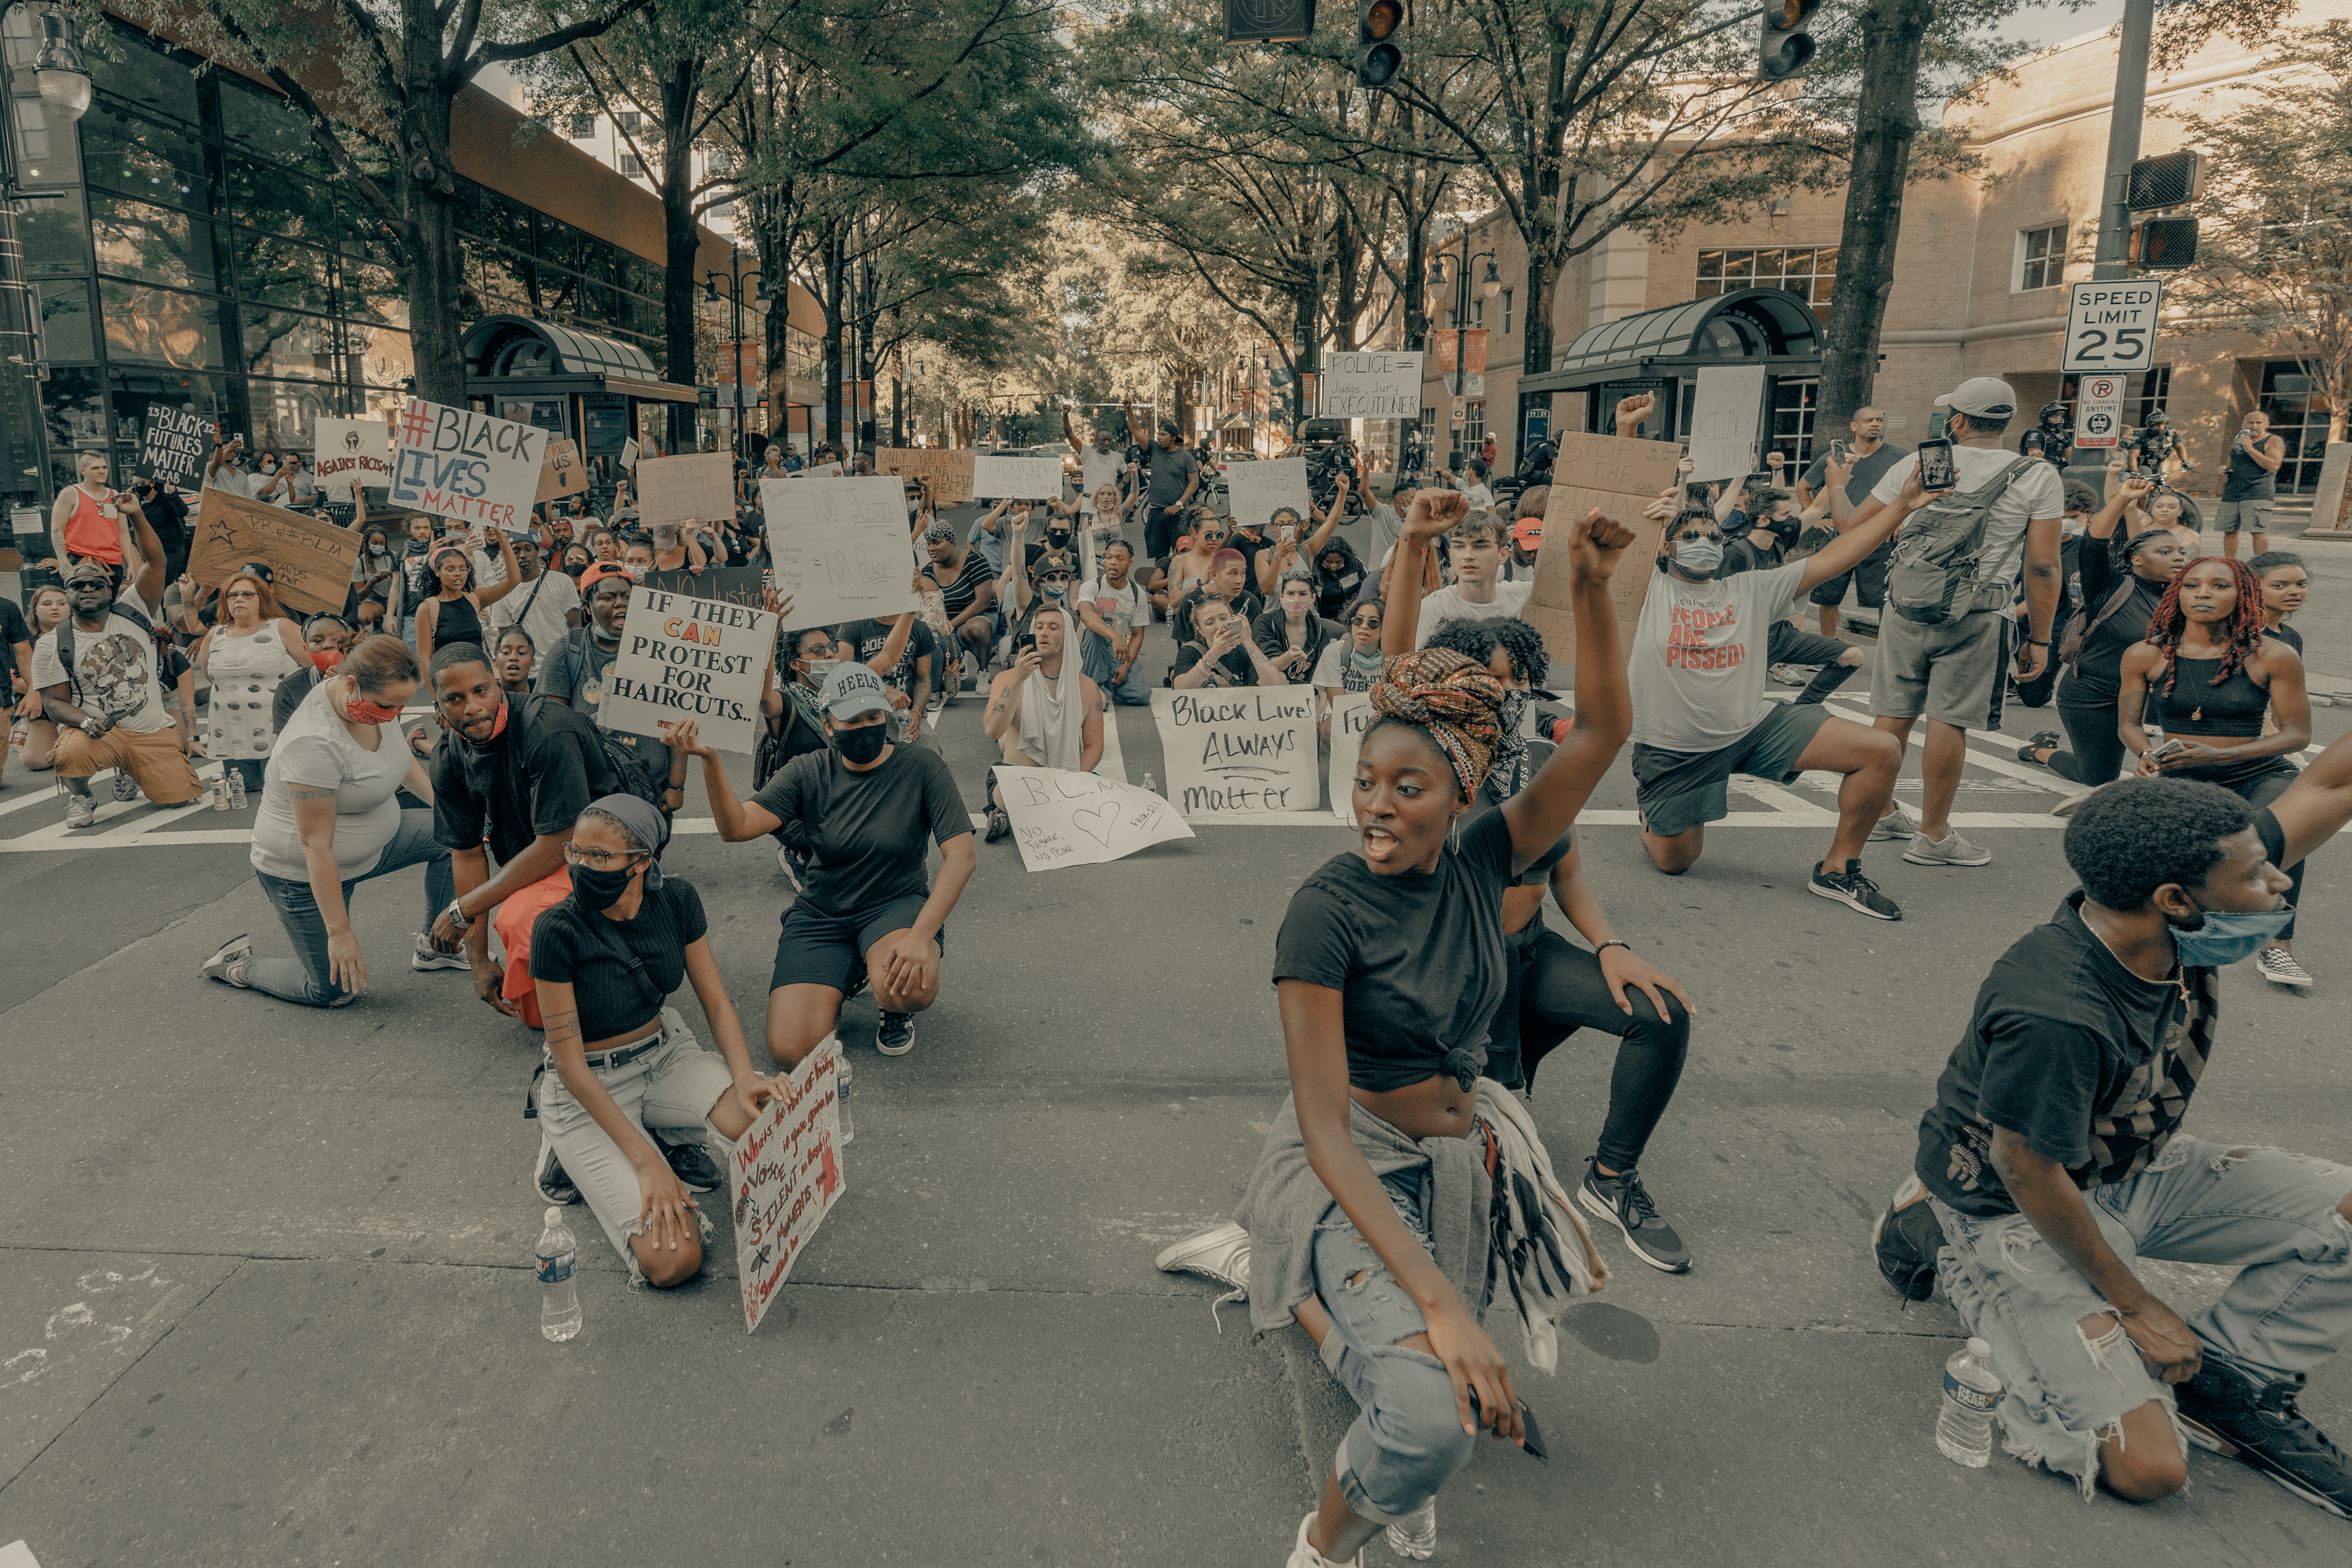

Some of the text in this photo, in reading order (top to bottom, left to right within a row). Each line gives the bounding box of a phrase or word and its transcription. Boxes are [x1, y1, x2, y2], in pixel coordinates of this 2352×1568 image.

[2079, 291, 2152, 306] SPEED
[2084, 310, 2141, 324] LIMIT
[2074, 328, 2147, 361] 25
[1333, 355, 1392, 373] POLICE
[1371, 381, 1398, 395] Jury
[1716, 375, 1755, 408] STOP
[1329, 396, 1418, 414] EXECUTIONER
[148, 407, 216, 437] 13 BLACK 12
[402, 400, 534, 463] #BLACK
[1698, 409, 1744, 442] KILLING
[146, 427, 203, 456] FUTURES
[1564, 438, 1634, 463] STOP
[142, 446, 200, 478] MATTER.
[317, 455, 389, 477] AGAINST RACISM
[880, 451, 962, 464] ONLY YOU CAN
[989, 461, 1058, 472] FIGHTING
[152, 468, 180, 484] ACAB
[394, 448, 490, 501] LIVES
[929, 474, 971, 485] RUTALITY
[1004, 473, 1042, 482] FOR MY
[1235, 463, 1302, 480] RASTAFARIAN
[1594, 462, 1635, 482] THE
[933, 483, 970, 495] PEACE
[993, 485, 1060, 494] SONS FUTURE
[422, 488, 515, 527] MATTER
[811, 490, 838, 522] NO
[1239, 499, 1273, 515] WANT
[266, 559, 308, 580] STANDS
[824, 549, 852, 588] NO
[645, 591, 764, 630] IF THEY
[1672, 603, 1736, 629] PEOPLE
[663, 617, 722, 647] CAN
[1667, 625, 1709, 648] ARE
[629, 636, 752, 674] PROTEST
[1667, 643, 1746, 670] PISSED!
[661, 665, 711, 694] FOR
[837, 673, 880, 698] HEELS
[612, 677, 752, 722] HAIRCUTS...
[1172, 696, 1248, 726] Black
[1203, 730, 1295, 765] ALWAYS
[747, 1161, 786, 1189] VOICE
[750, 1163, 798, 1246] SILENT
[1957, 1391, 1986, 1409] PARK
[1958, 1385, 1986, 1401] DEER
